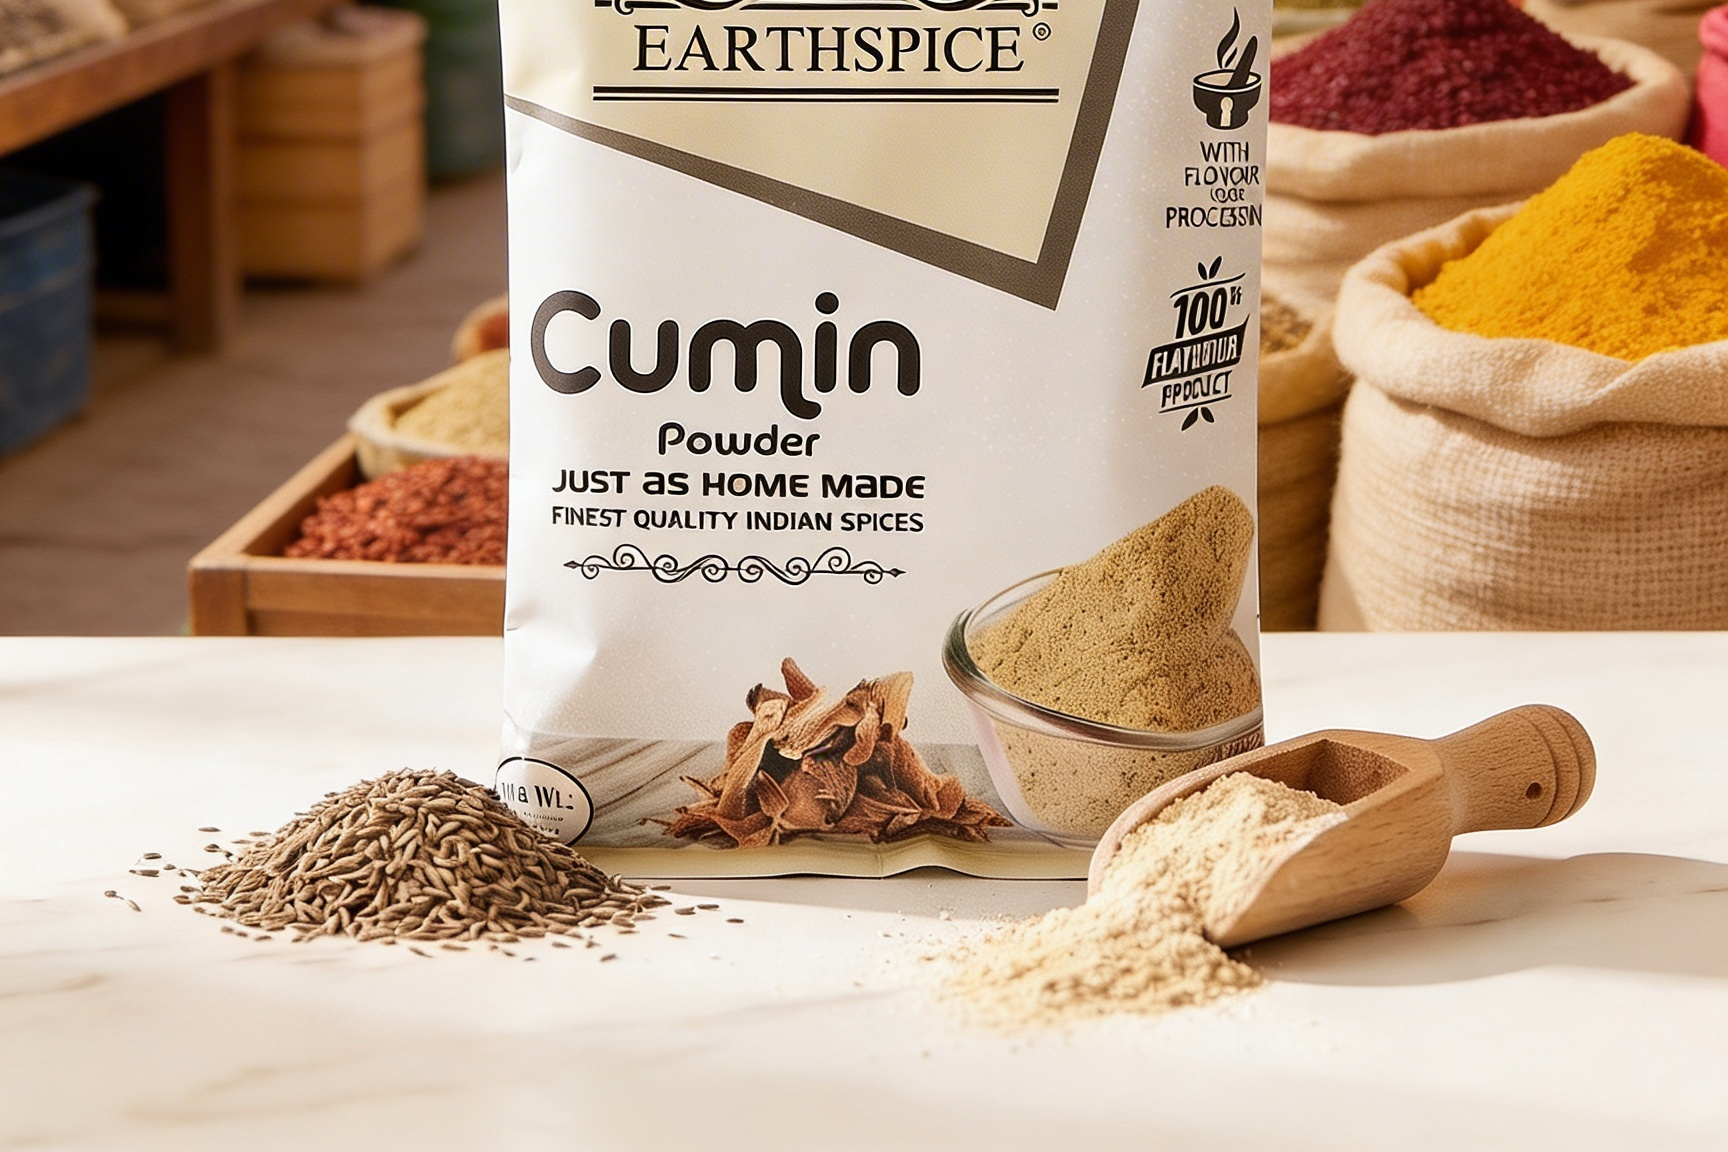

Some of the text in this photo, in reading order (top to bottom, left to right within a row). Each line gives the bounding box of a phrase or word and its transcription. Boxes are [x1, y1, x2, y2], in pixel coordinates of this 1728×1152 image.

[632, 25, 1025, 73] EARTHSPICE
[1200, 141, 1249, 163] WITH
[530, 290, 921, 419] Cumin
[657, 422, 821, 457] Powder
[552, 469, 630, 495] JUST
[702, 472, 809, 498] HOME
[552, 506, 924, 533] FINEST QUALITY INDIAN SPICES
